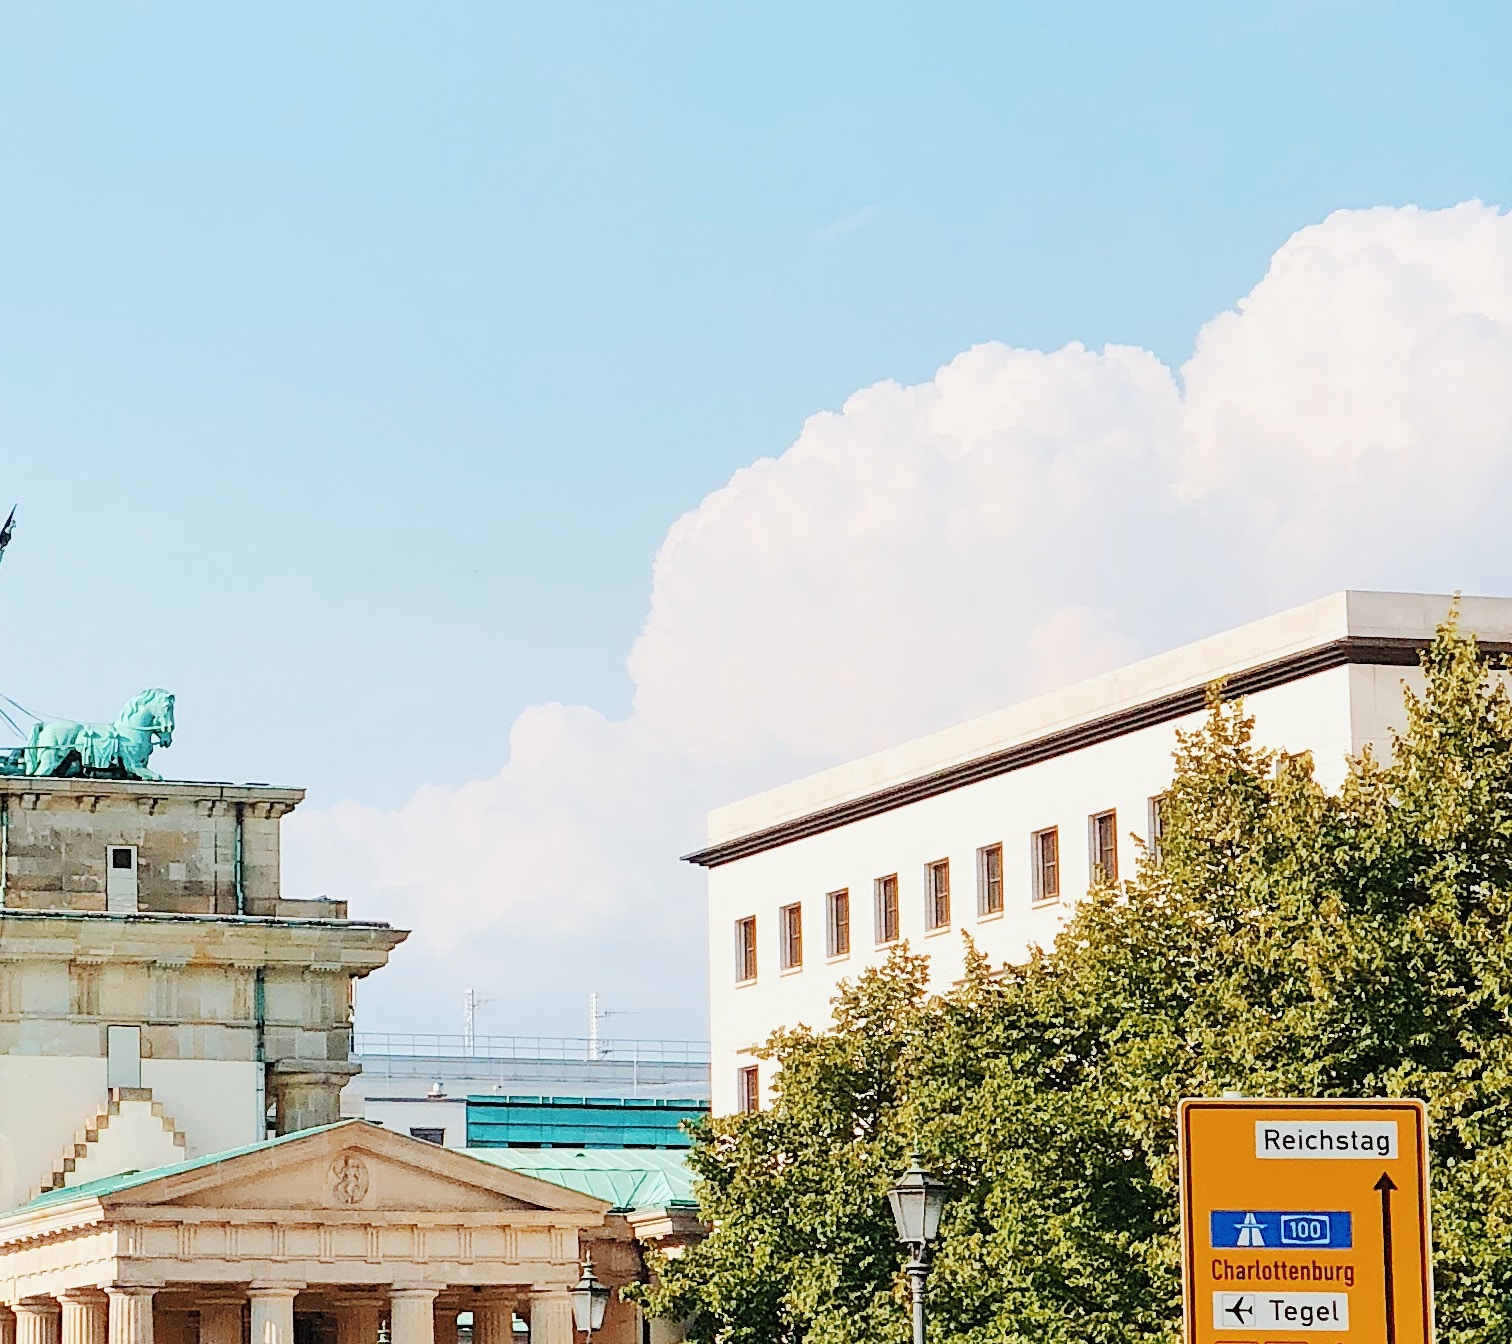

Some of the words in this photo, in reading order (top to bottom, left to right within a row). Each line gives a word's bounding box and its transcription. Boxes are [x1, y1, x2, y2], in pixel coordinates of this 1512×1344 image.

[1264, 1129, 1390, 1156] Reichstag
[1289, 1221, 1321, 1239] 100
[1211, 1259, 1355, 1287] Charlottenburg
[1269, 1300, 1339, 1326] Tegel
